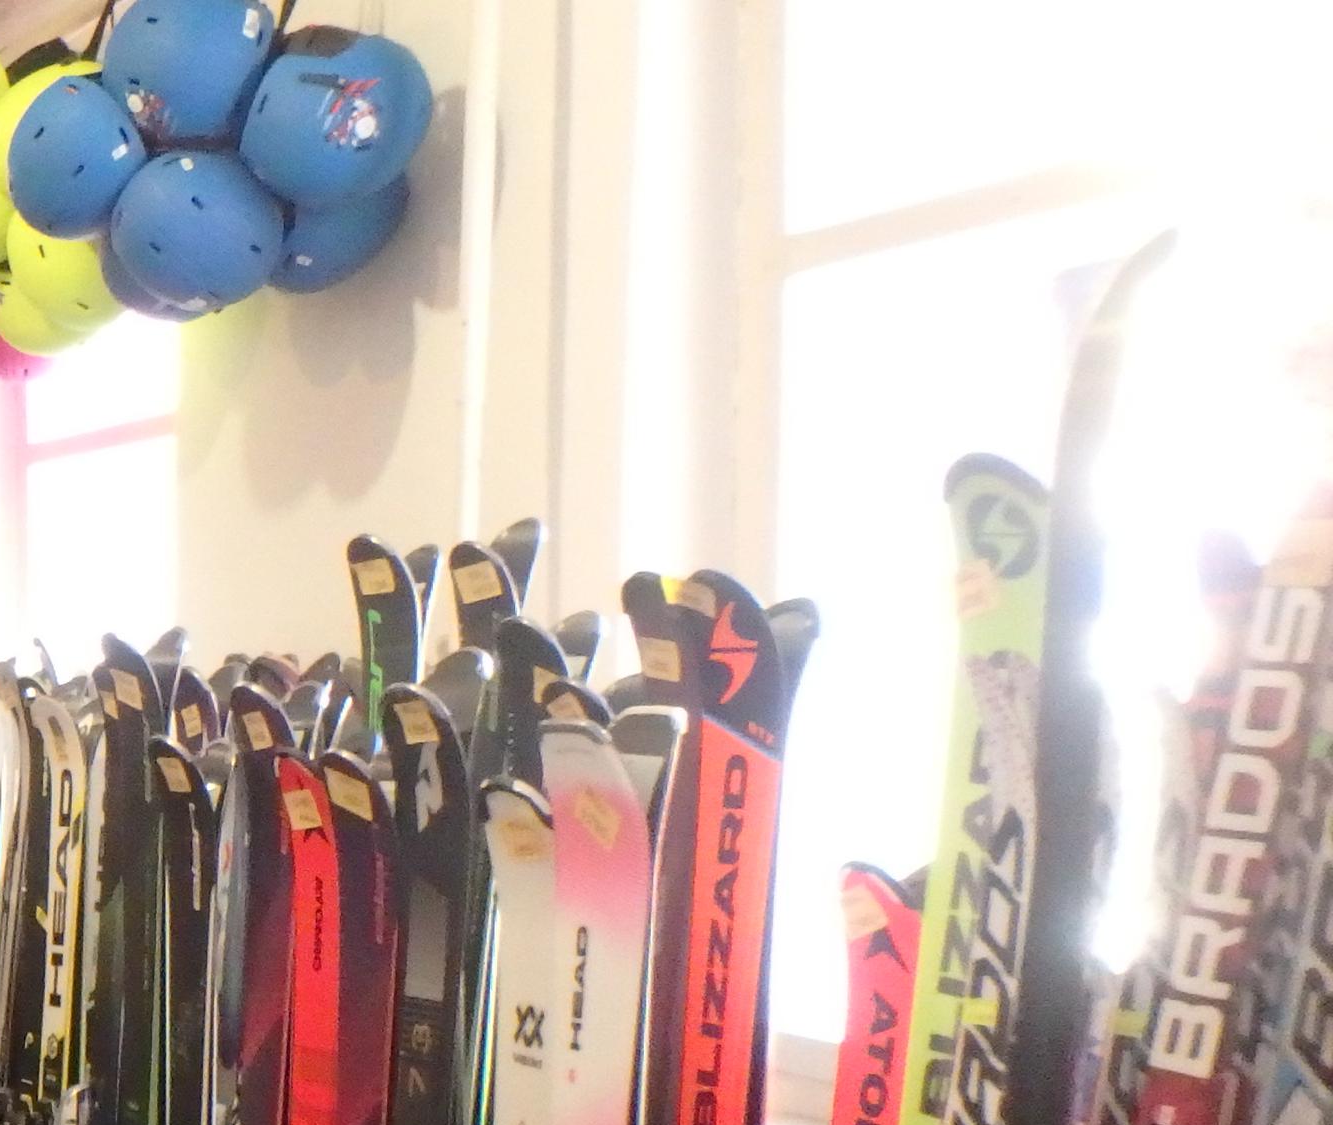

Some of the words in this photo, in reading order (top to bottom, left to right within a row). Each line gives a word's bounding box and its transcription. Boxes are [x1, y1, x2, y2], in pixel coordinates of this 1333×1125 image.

[48, 769, 73, 1008] HEAD
[1148, 585, 1326, 1080] BRADOS
[569, 925, 588, 1051] HEAD
